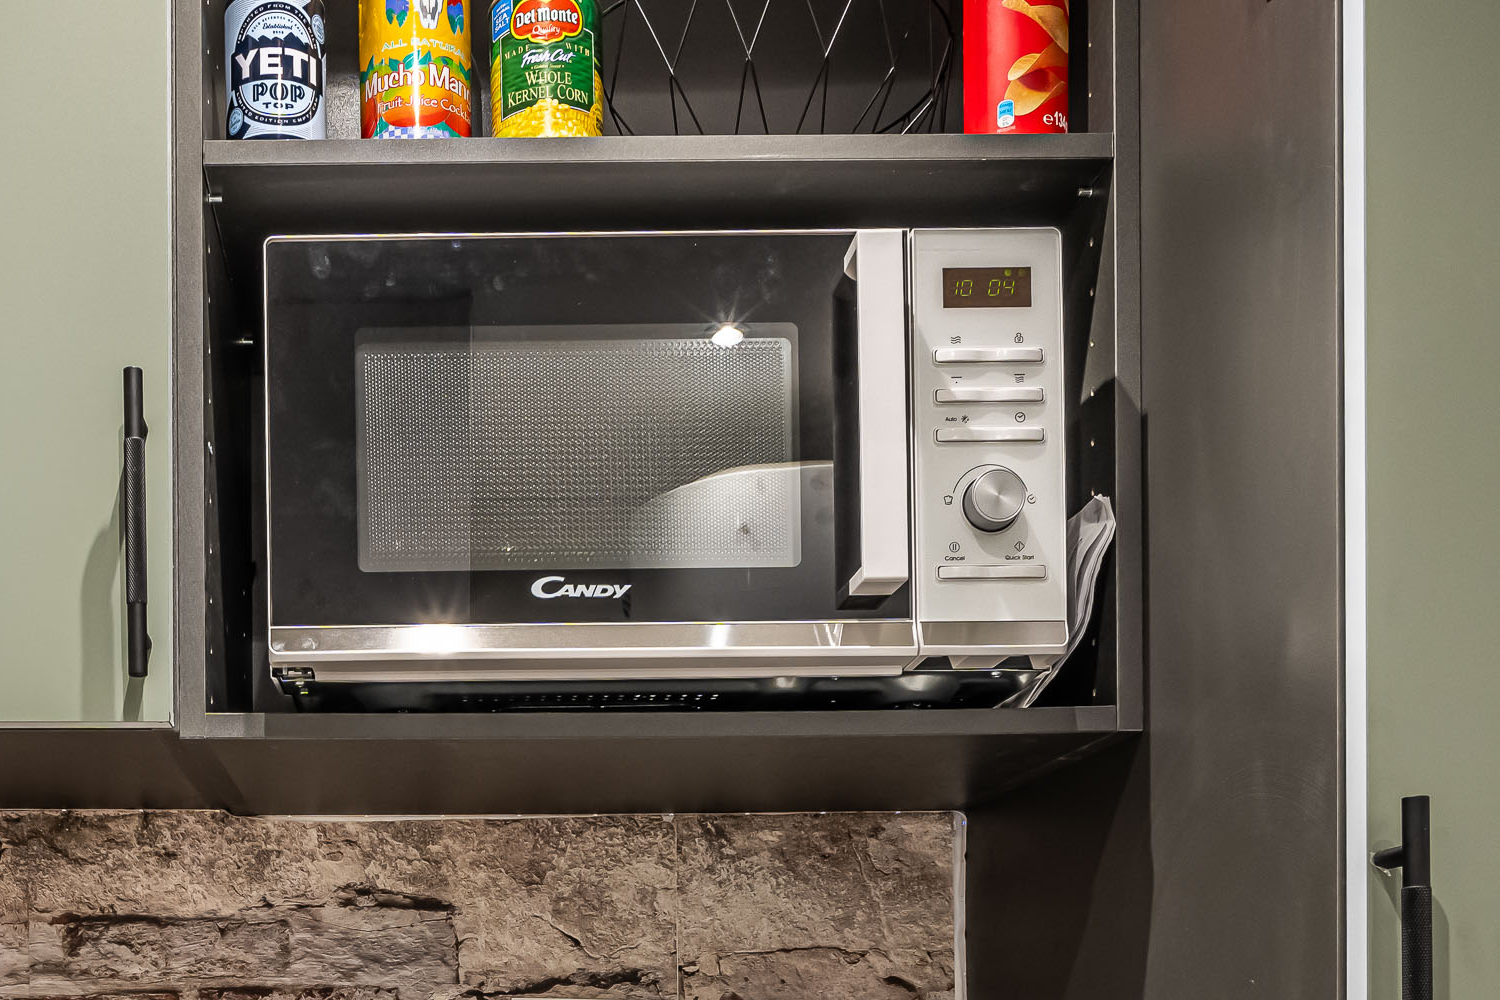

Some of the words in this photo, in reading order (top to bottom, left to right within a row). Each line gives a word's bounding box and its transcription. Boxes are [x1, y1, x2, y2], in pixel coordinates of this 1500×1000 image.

[494, 17, 510, 34] SALT
[496, 13, 508, 26] SEA
[516, 8, 536, 28] Del
[536, 6, 578, 25] Monte
[532, 24, 560, 36] Quality
[381, 39, 408, 52] ALL
[504, 44, 530, 60] MADE
[566, 42, 590, 56] WITH
[235, 47, 317, 87] YETI
[365, 62, 426, 102] Mucho
[525, 70, 572, 86] WHOLE
[253, 82, 305, 102] POP
[508, 84, 554, 108] KERNEL
[557, 84, 588, 104] CORN
[262, 101, 294, 110] TOP
[378, 96, 403, 113] Fruit
[954, 280, 973, 296] 10
[988, 280, 1016, 296] 04
[530, 576, 632, 598] CANDY
